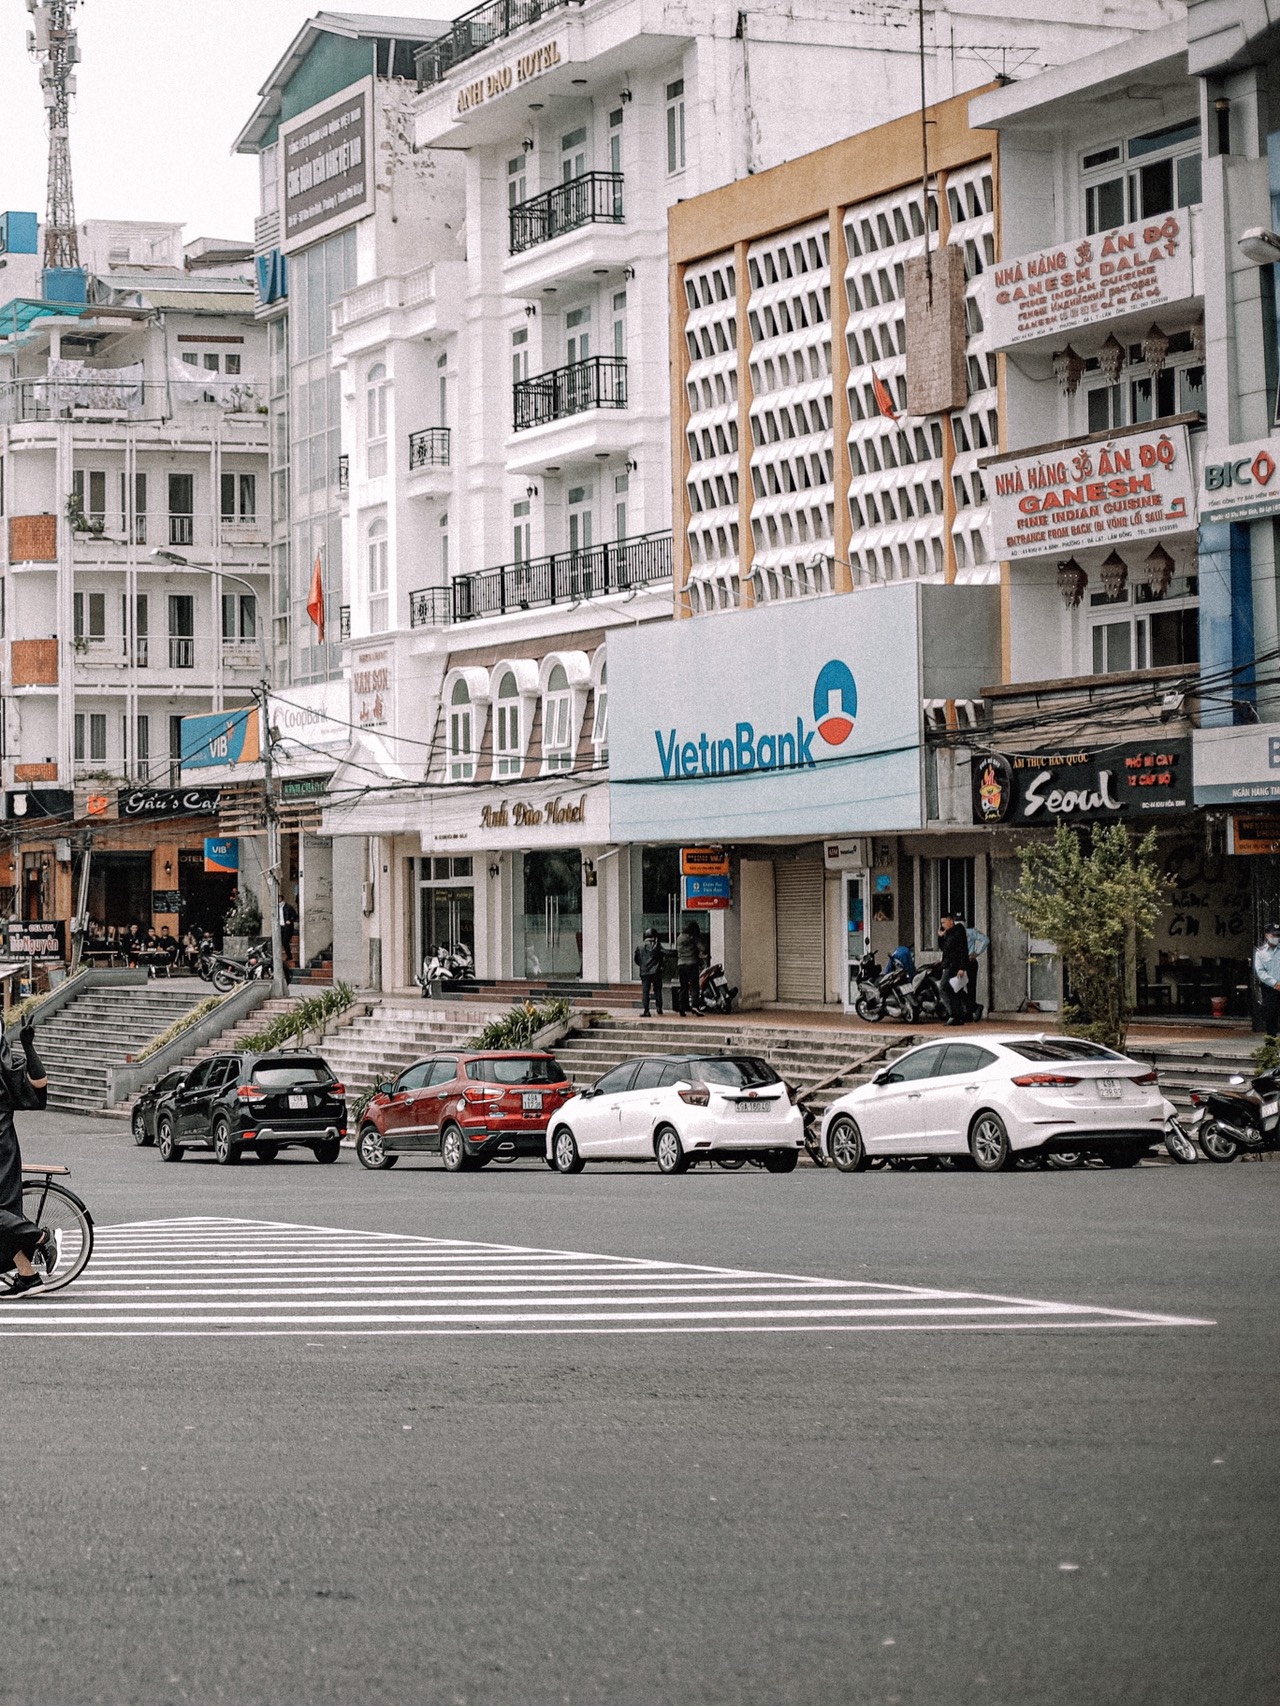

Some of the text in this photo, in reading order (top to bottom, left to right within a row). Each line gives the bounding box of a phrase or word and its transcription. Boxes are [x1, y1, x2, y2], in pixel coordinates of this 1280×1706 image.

[517, 41, 561, 82] HOTEL
[996, 267, 1091, 305] GANESH
[995, 434, 1175, 495] NHÀ HÀNG ẤN ĐỘ
[1019, 473, 1153, 513] GANESH
[1017, 494, 1163, 529] FINE INDIAN CUISINE
[209, 735, 228, 758] VIB
[655, 716, 817, 780] VietinBank
[1156, 753, 1174, 767] CAY
[125, 792, 230, 815] Gấu's Caf
[1024, 769, 1122, 817] Seoul
[1232, 788, 1249, 798] NGÂN
[1251, 786, 1269, 797] HÀNG
[479, 793, 587, 828] Anh Đào Hotel
[212, 845, 227, 855] VIB
